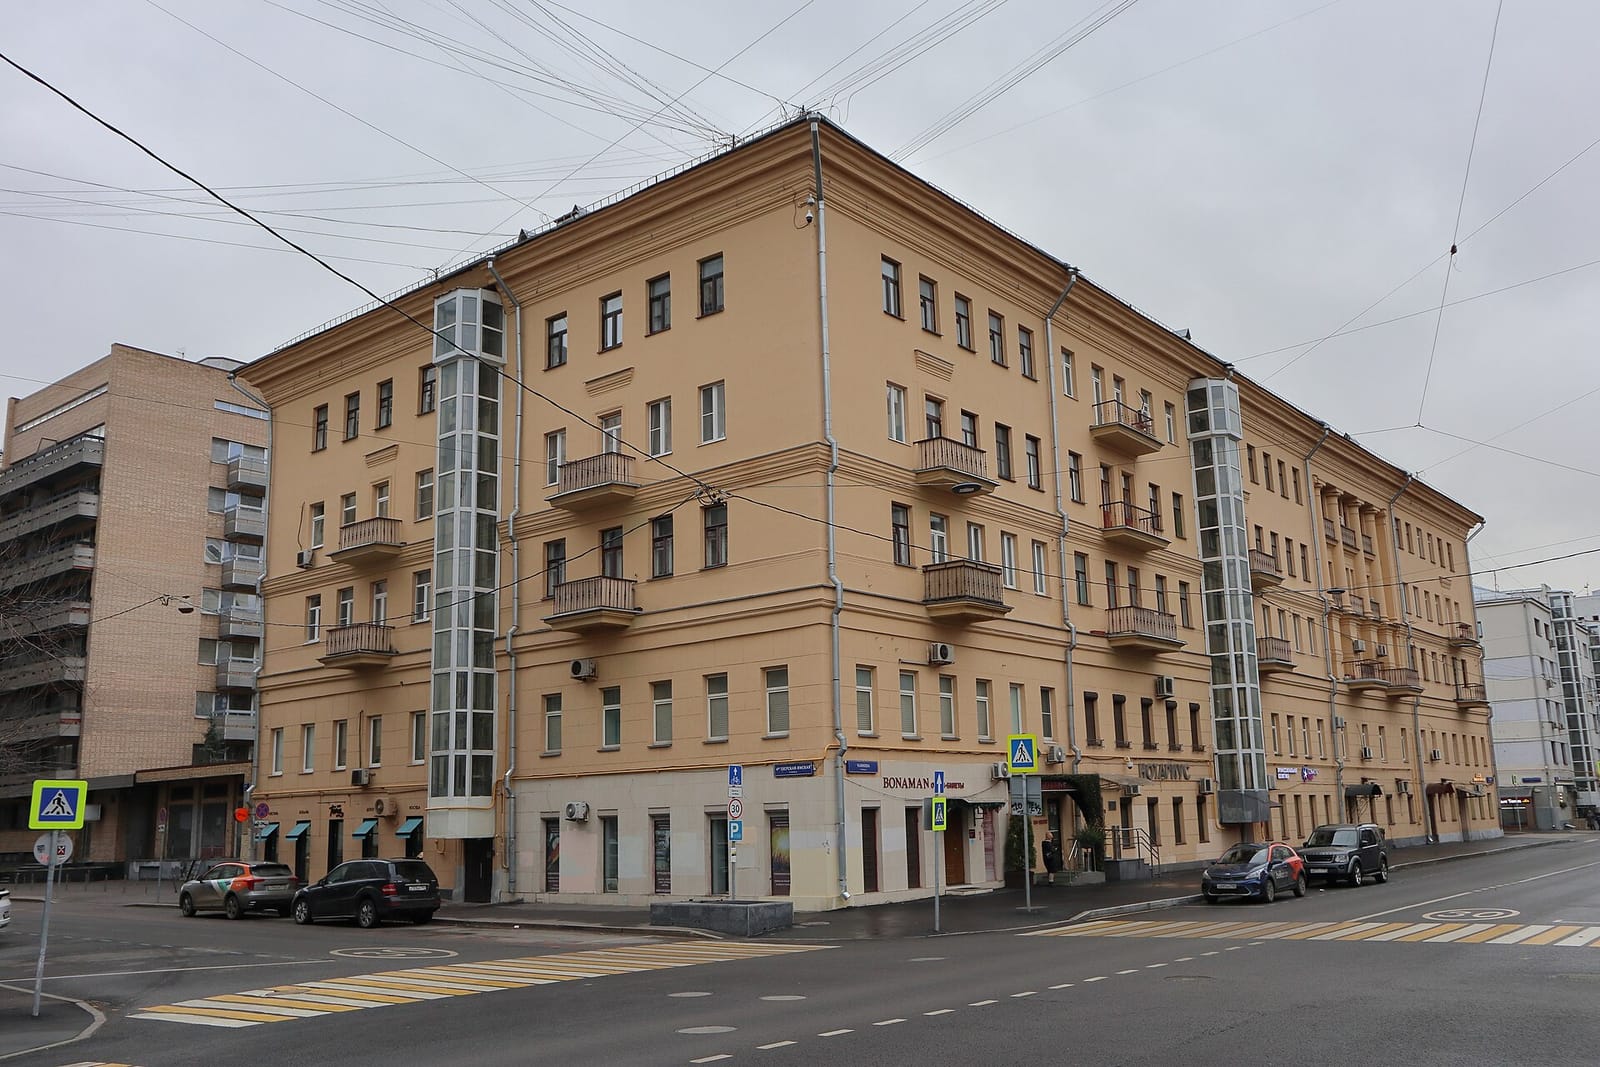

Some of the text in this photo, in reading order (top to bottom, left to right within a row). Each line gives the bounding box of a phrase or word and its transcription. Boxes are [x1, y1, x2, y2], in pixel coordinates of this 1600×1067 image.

[1138, 763, 1190, 780] НОТАРИУС
[883, 777, 929, 789] BONAMAN
[731, 804, 740, 813] 30
[730, 822, 739, 839] P
